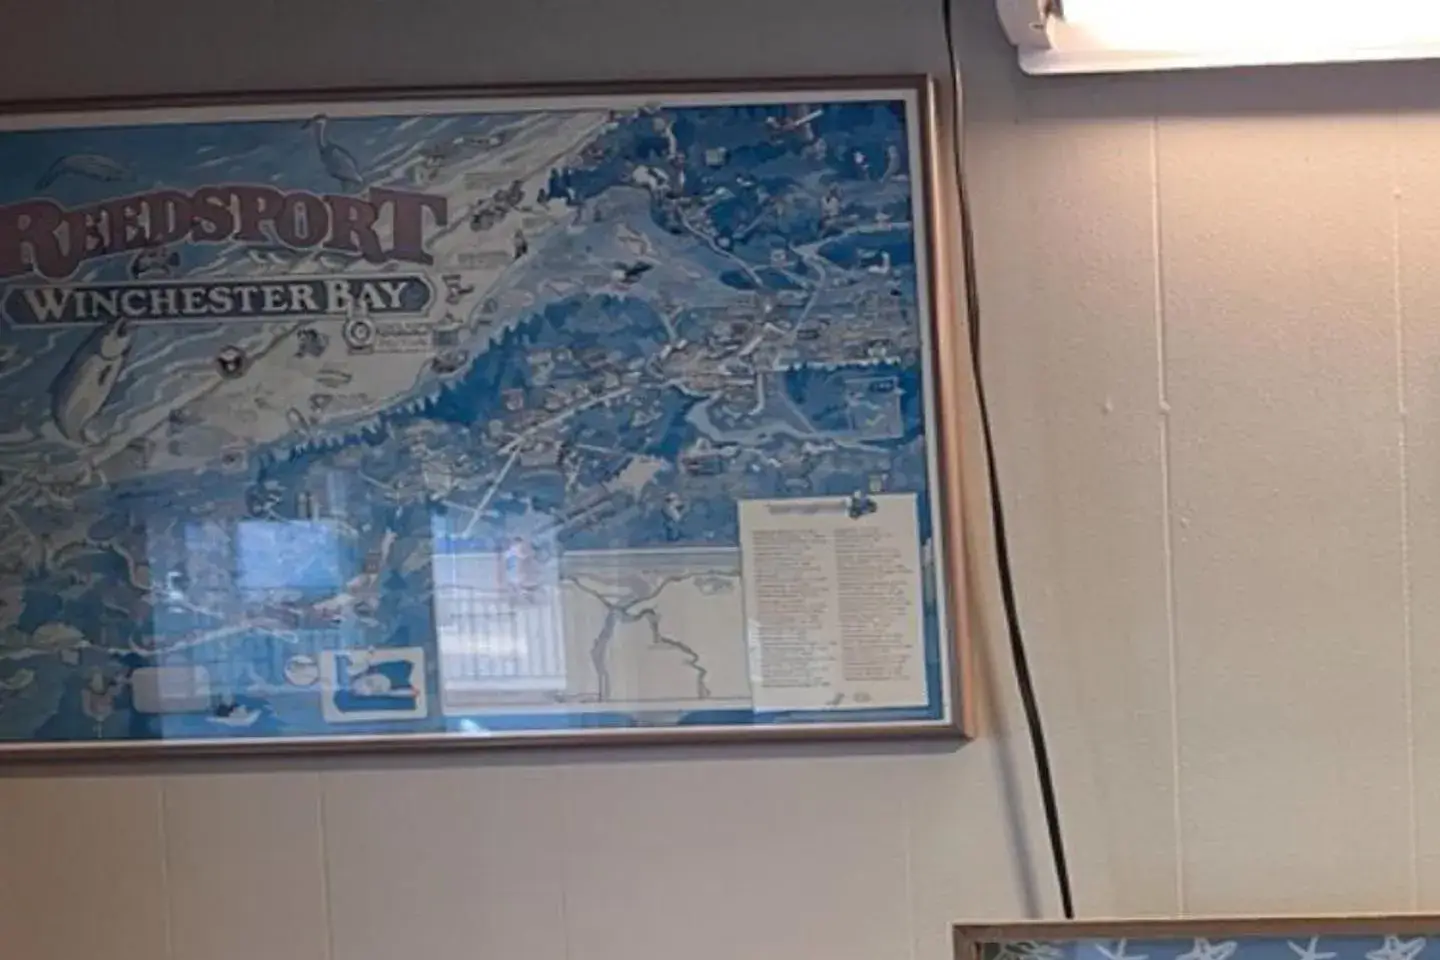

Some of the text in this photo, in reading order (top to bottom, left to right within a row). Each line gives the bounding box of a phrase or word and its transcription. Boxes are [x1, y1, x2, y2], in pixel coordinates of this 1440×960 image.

[0, 184, 447, 279] REEDSPORT
[22, 278, 409, 322] WINCHESTER BAY
